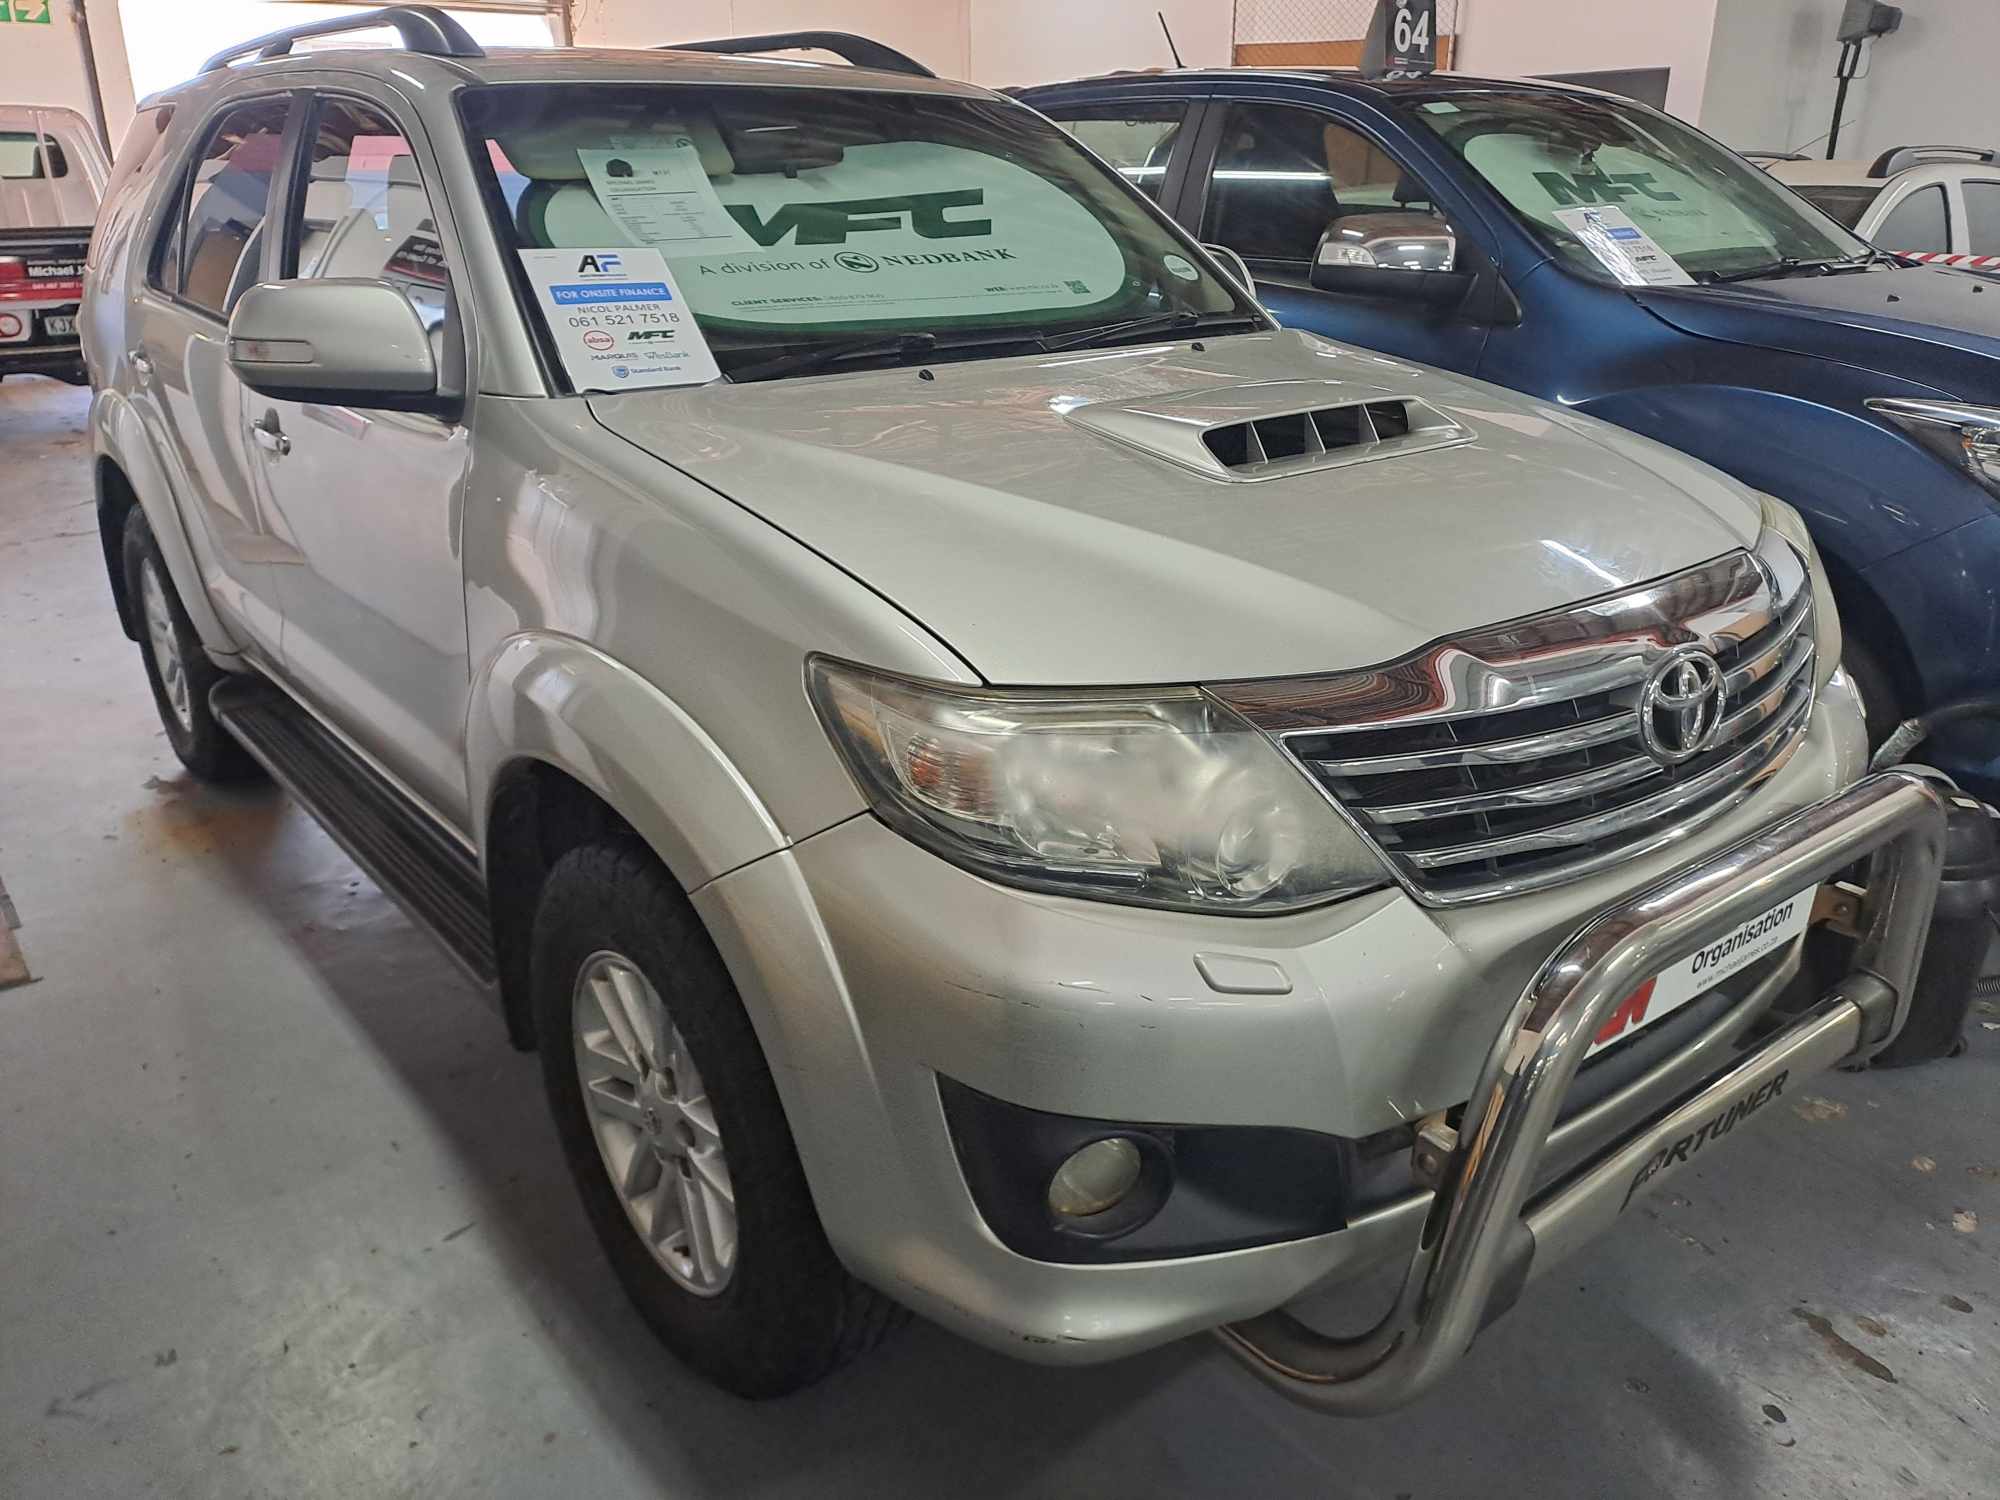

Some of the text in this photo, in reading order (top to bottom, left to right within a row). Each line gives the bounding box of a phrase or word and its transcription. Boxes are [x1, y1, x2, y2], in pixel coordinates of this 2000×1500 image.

[1394, 8, 1429, 54] 64
[699, 247, 1017, 277] A division of NEDBANK
[28, 264, 74, 277] Michael
[556, 286, 667, 300] FOR ONSITE FINANCE
[577, 303, 662, 314] NICOL PALMER
[568, 313, 680, 328] 061 521 7518
[627, 330, 676, 341] MFC
[1691, 901, 1794, 975] Organisation
